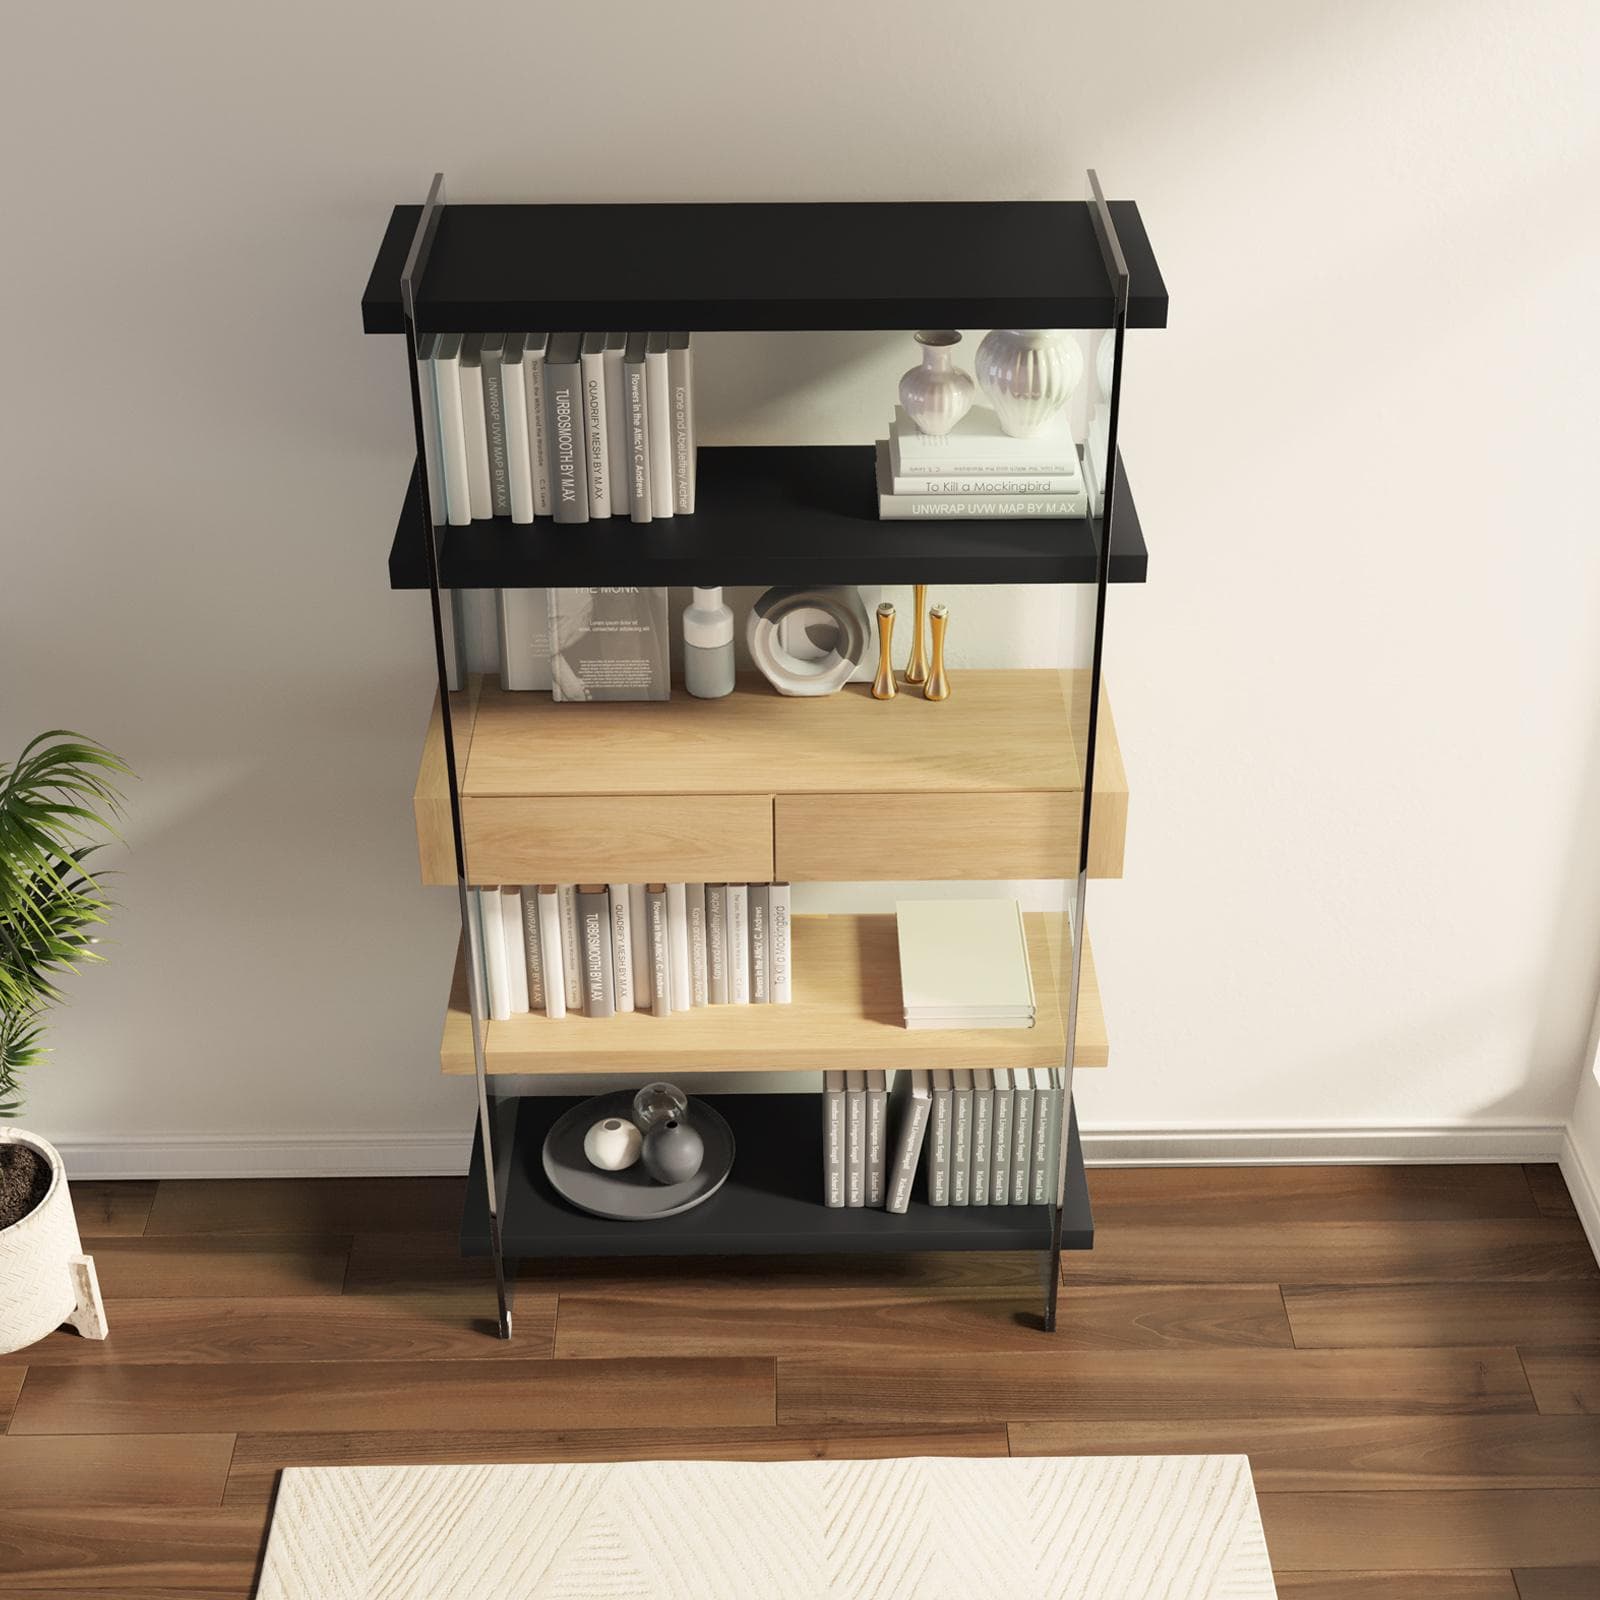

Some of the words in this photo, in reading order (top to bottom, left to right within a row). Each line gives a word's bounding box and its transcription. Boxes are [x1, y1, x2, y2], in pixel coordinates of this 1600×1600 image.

[488, 377, 500, 420] UNWRAP
[631, 373, 642, 403] Flowers
[676, 386, 685, 410] Kane
[589, 380, 601, 430] QUADRIFY
[556, 389, 573, 462] TURBOSMOOTH
[633, 413, 643, 425] the
[677, 411, 686, 429] and
[491, 422, 502, 444] UVW
[494, 447, 503, 467] MAP
[592, 432, 602, 460] MESH
[495, 469, 505, 483] BY
[560, 464, 574, 477] BY
[593, 461, 602, 475] BY
[635, 465, 645, 498] Andrews
[926, 482, 939, 492] To
[943, 482, 958, 492] Kill
[962, 484, 970, 492] a
[974, 481, 1051, 494] Mockingbird
[679, 480, 689, 509] Archer
[912, 504, 965, 514] UNWRAP
[968, 504, 995, 514] UVW
[999, 503, 1025, 513] MAP
[1028, 503, 1043, 512] BY
[615, 904, 626, 942] QUADRIFY
[586, 913, 602, 970] TURBOSMOOTH
[619, 944, 627, 966] MESH
[590, 972, 603, 982] BY
[619, 967, 627, 978] BY
